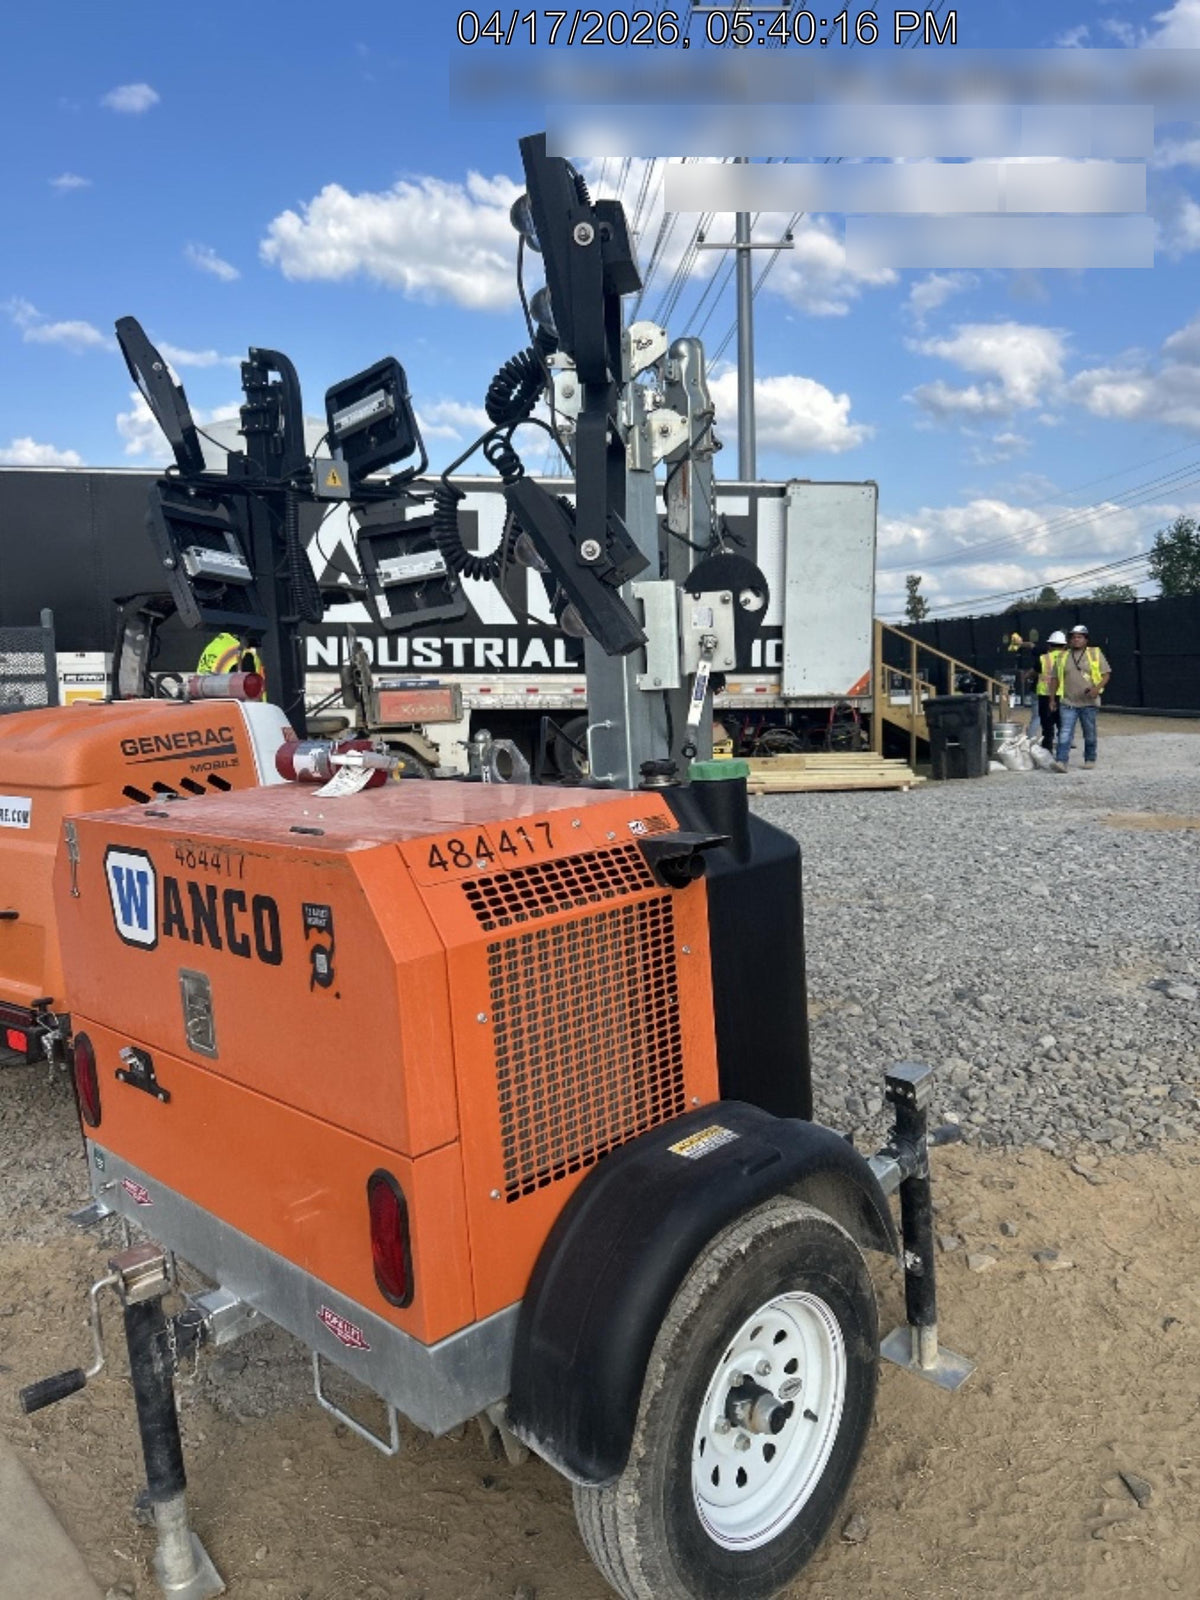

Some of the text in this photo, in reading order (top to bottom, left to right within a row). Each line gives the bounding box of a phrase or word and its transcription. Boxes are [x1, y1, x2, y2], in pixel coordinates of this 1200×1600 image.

[305, 636, 579, 669] NDUSTRIAL
[120, 726, 234, 756] GENERAC
[190, 758, 239, 773] MOBILE
[428, 822, 553, 872] 484417
[174, 848, 247, 880] 484417
[111, 864, 283, 966] WANCO
